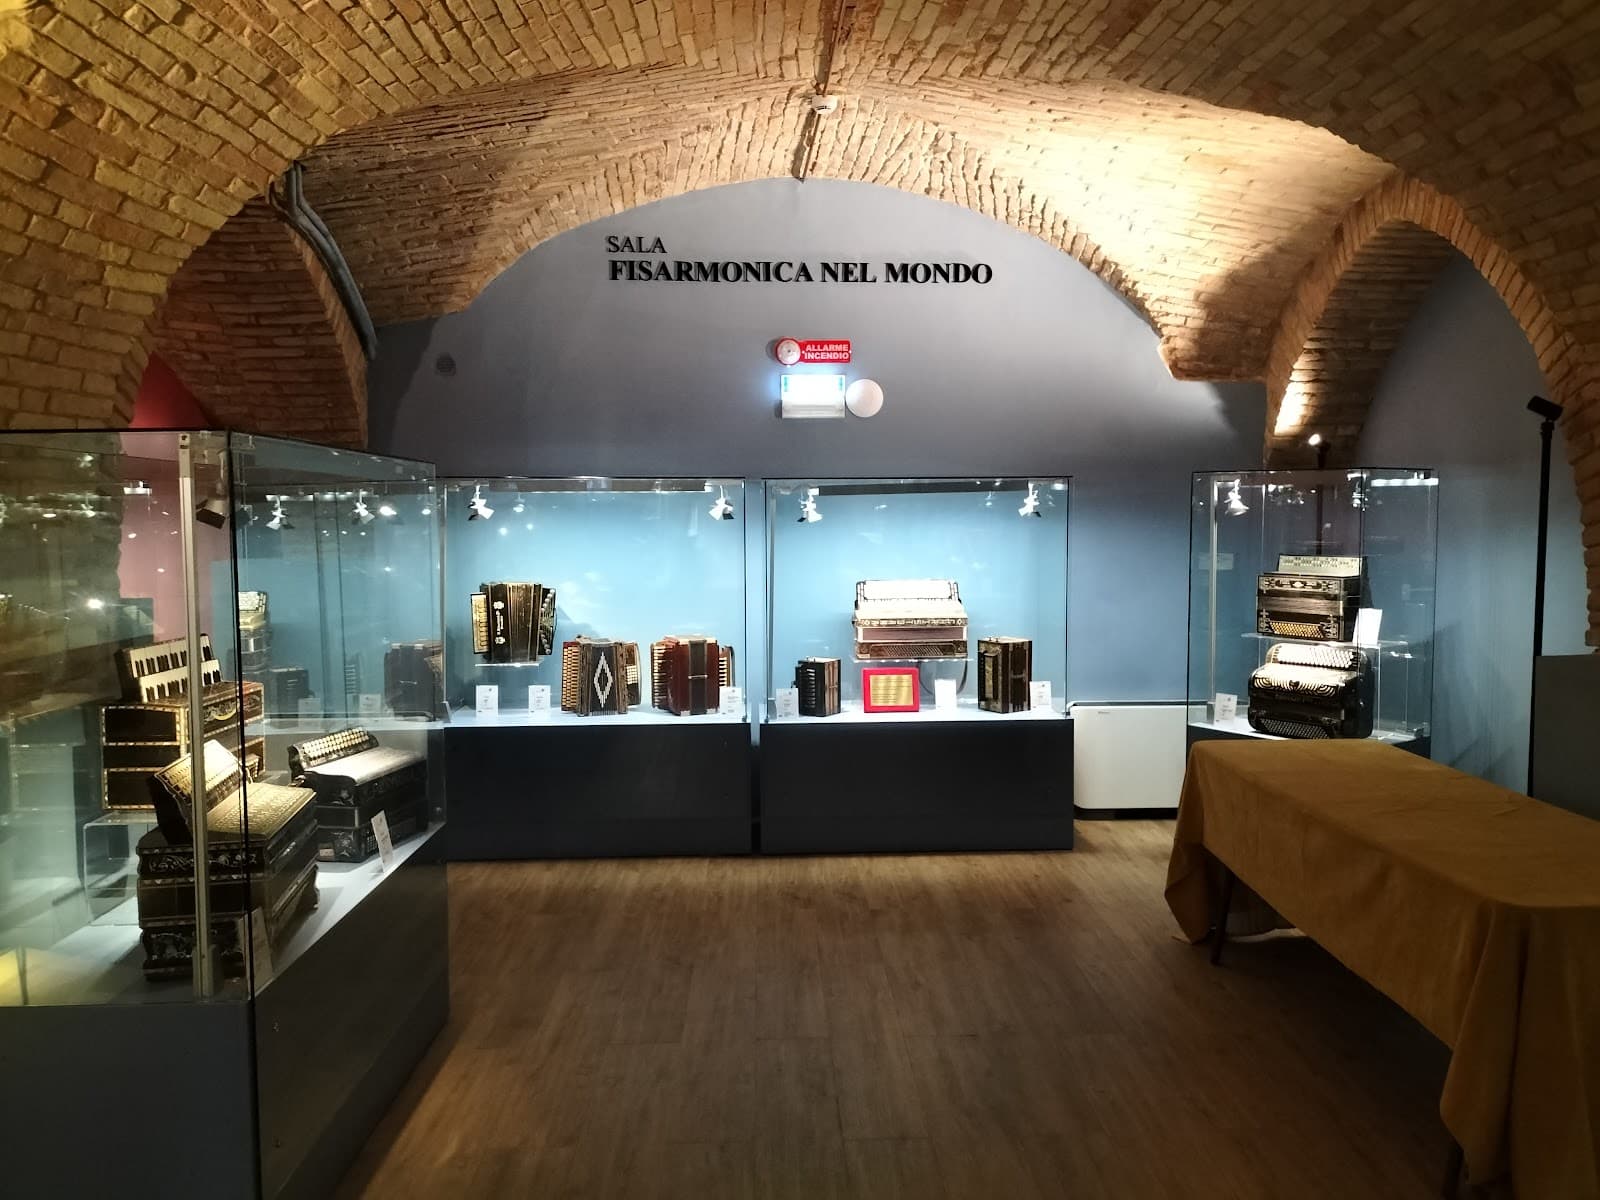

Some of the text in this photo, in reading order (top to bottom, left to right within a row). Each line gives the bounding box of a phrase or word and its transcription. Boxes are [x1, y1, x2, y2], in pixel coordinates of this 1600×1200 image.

[607, 235, 667, 253] SALA
[608, 260, 993, 284] FISARMONICA NEL MONDO
[805, 344, 849, 352] ALLARME
[804, 352, 849, 360] INCENDIO
